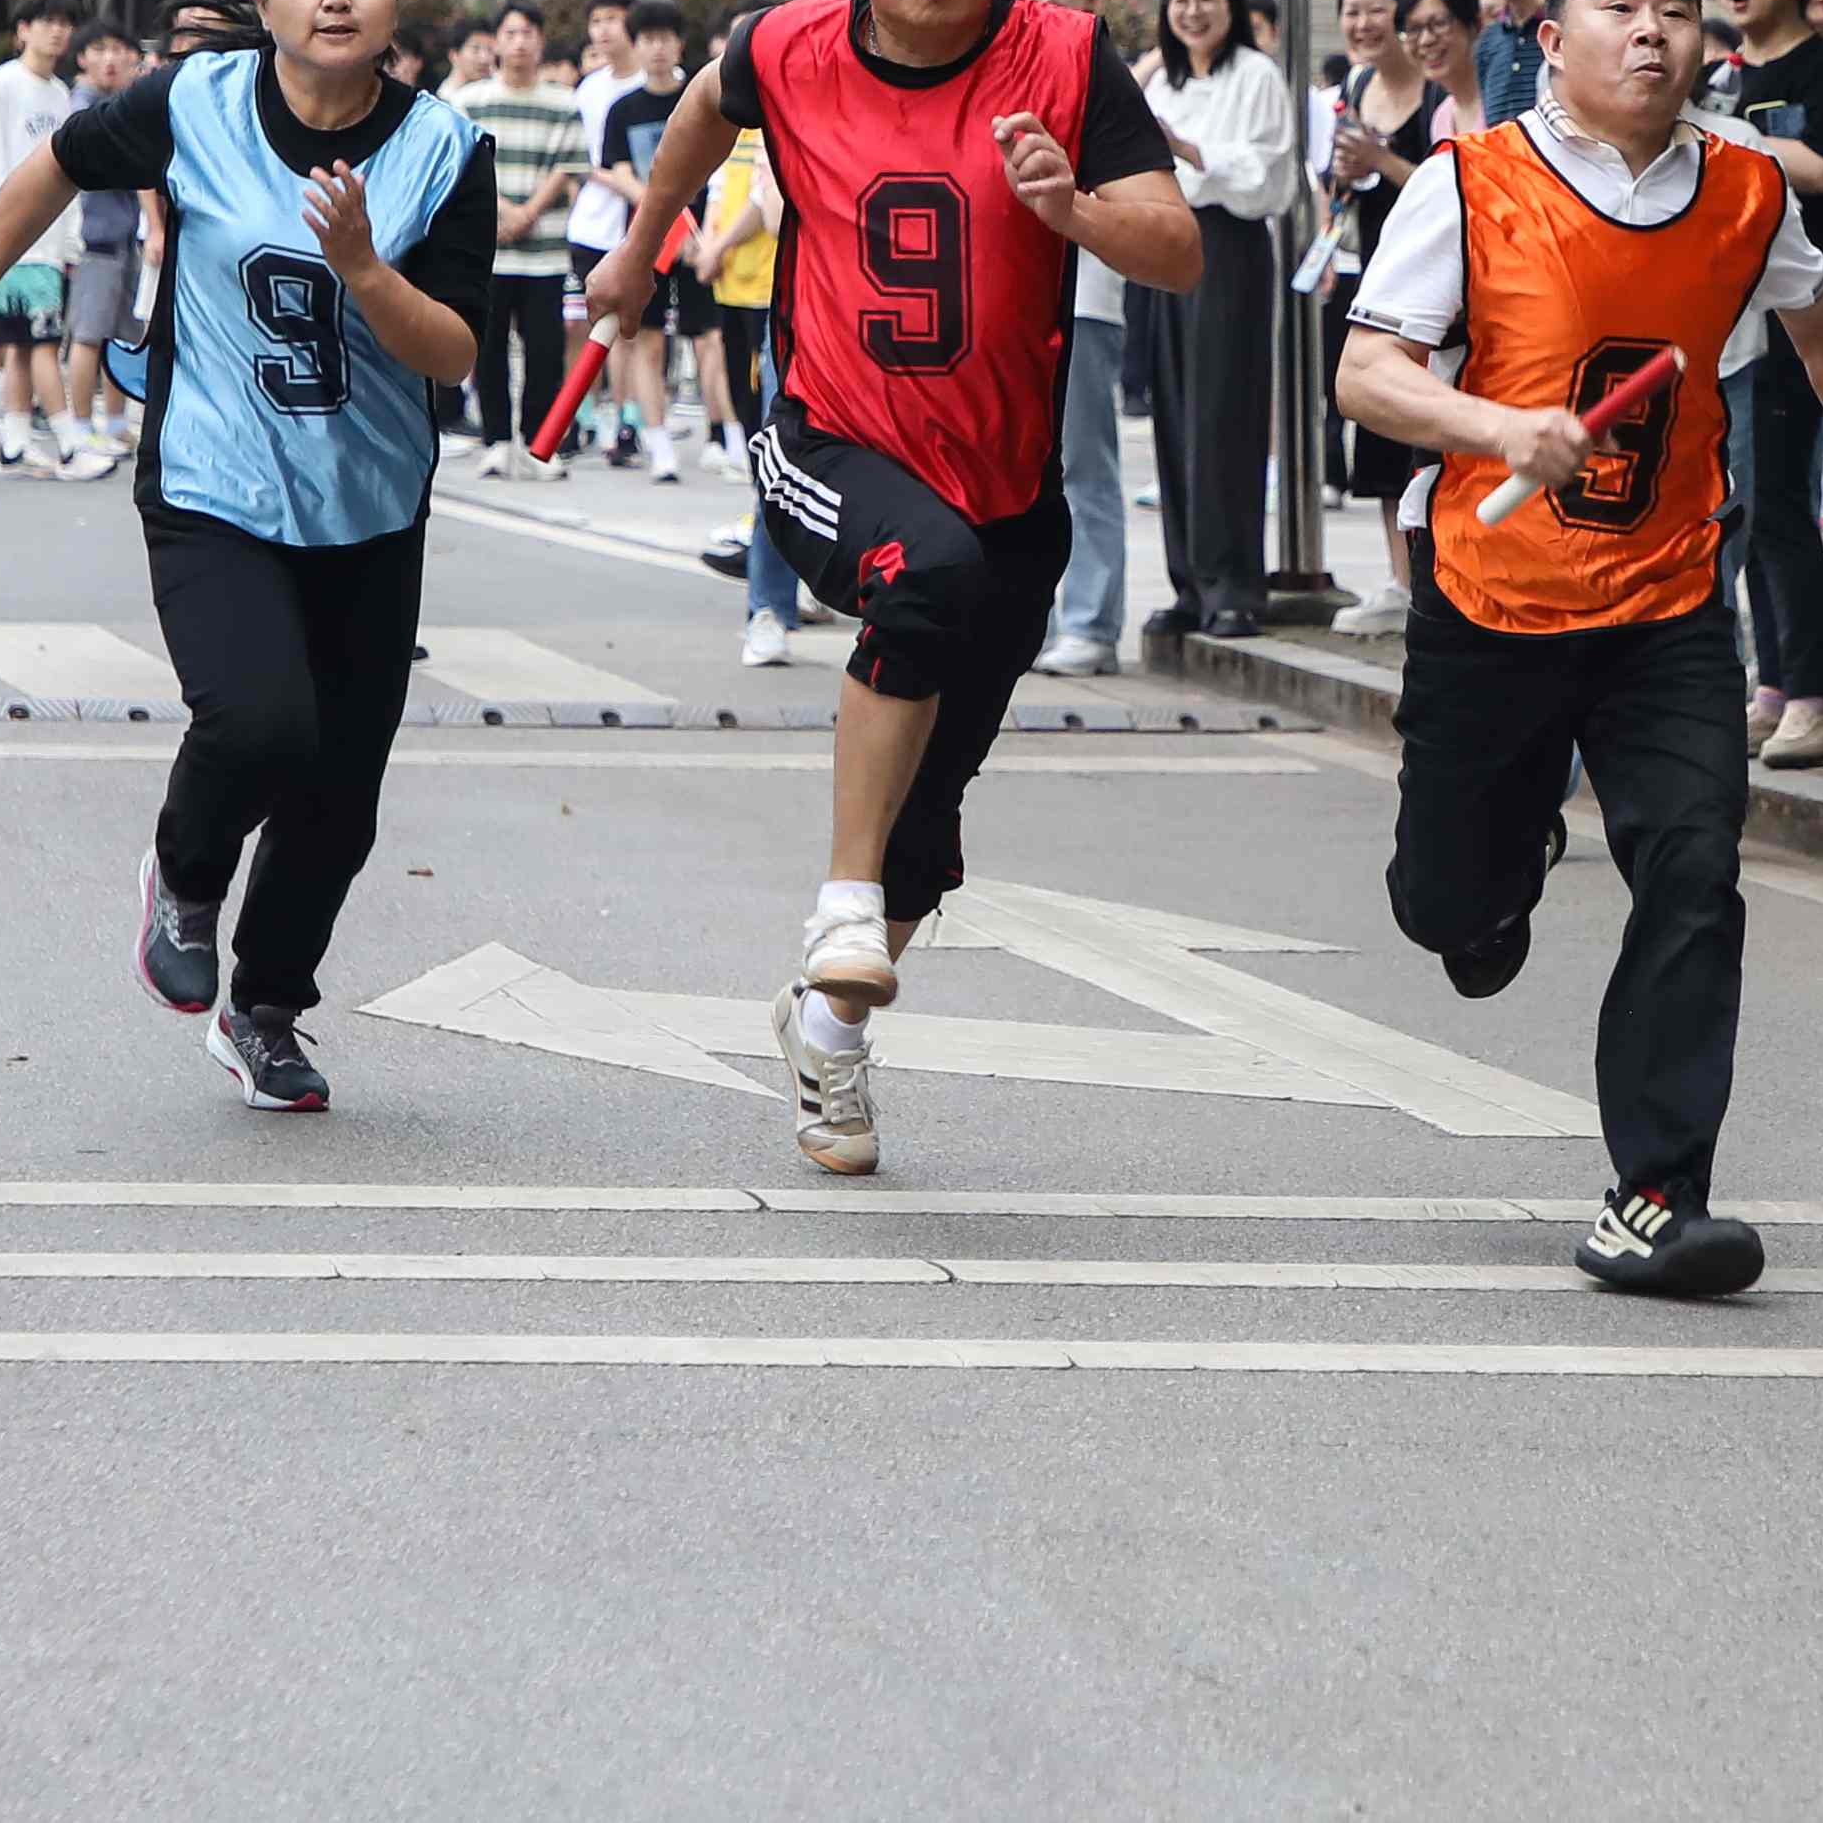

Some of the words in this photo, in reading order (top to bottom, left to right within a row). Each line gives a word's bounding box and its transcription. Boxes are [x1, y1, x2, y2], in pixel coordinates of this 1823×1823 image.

[238, 243, 351, 415] 9
[860, 172, 973, 376] 9
[1544, 337, 1684, 535] 9
